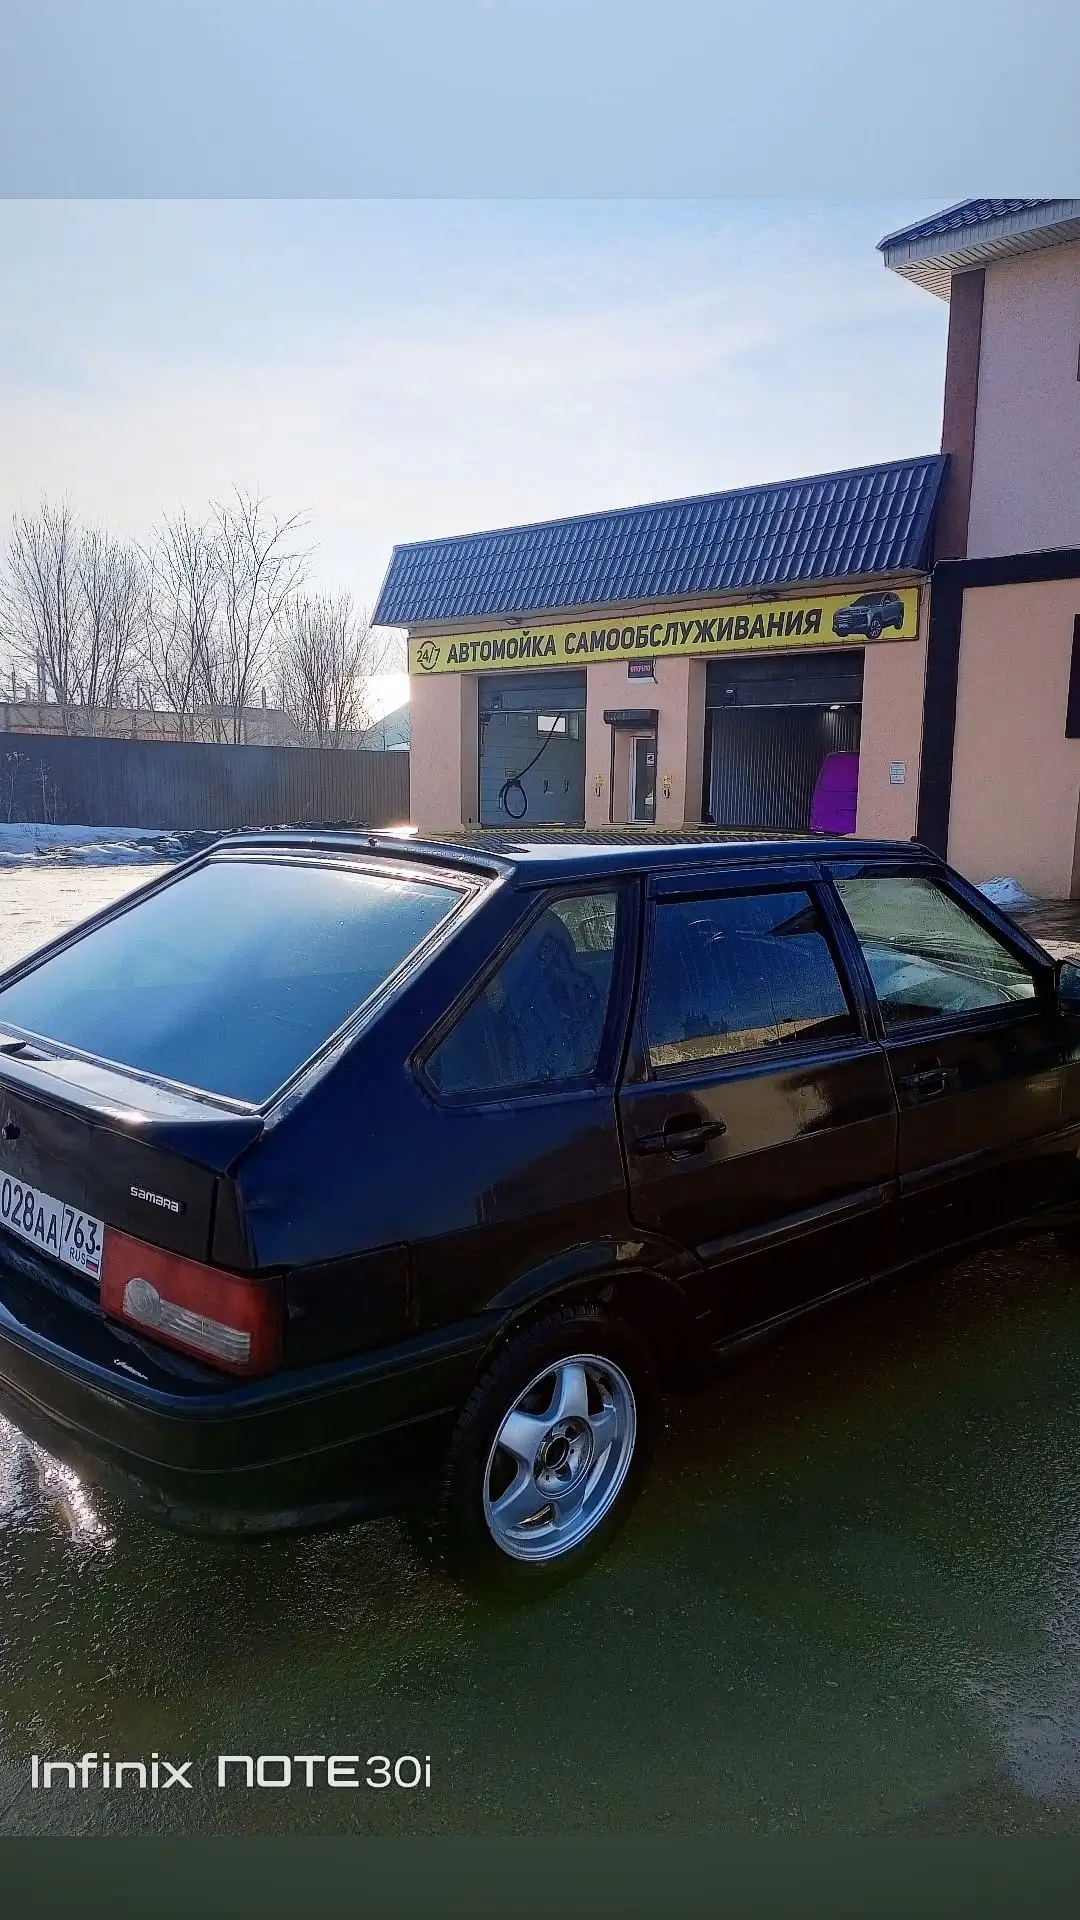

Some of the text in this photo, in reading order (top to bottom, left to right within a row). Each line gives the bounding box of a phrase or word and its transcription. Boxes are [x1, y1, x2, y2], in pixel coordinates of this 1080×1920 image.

[416, 608, 823, 664] 24/7 АВТОМОЙКА САМООБСЛУЖИВАНИЯ
[64, 1208, 98, 1255] 763
[69, 1246, 86, 1266] RUS
